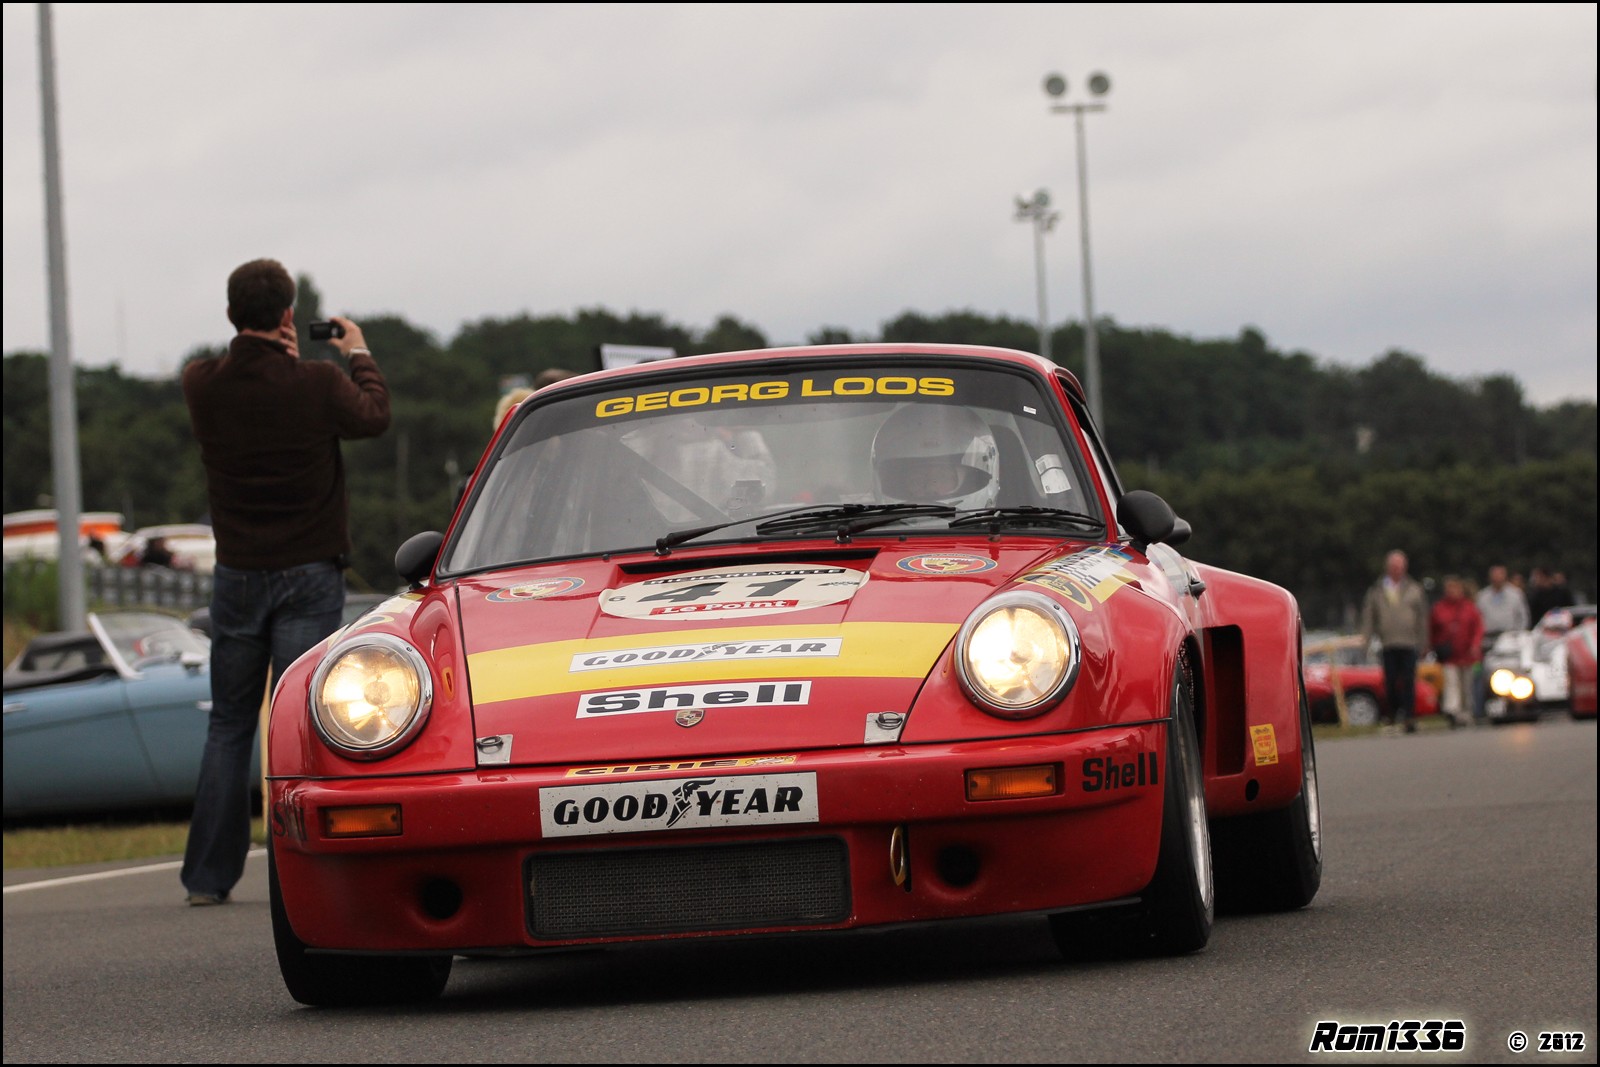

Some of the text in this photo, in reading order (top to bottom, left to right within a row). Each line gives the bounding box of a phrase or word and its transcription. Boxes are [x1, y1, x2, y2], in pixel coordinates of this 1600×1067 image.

[595, 376, 955, 418] GEORG LOOS
[636, 578, 806, 604] 41
[661, 599, 788, 615] Le Point
[583, 642, 828, 667] GOOD YEAR
[586, 683, 803, 714] Shell
[1082, 751, 1159, 792] Shell
[553, 786, 804, 825] GOOD YEAR
